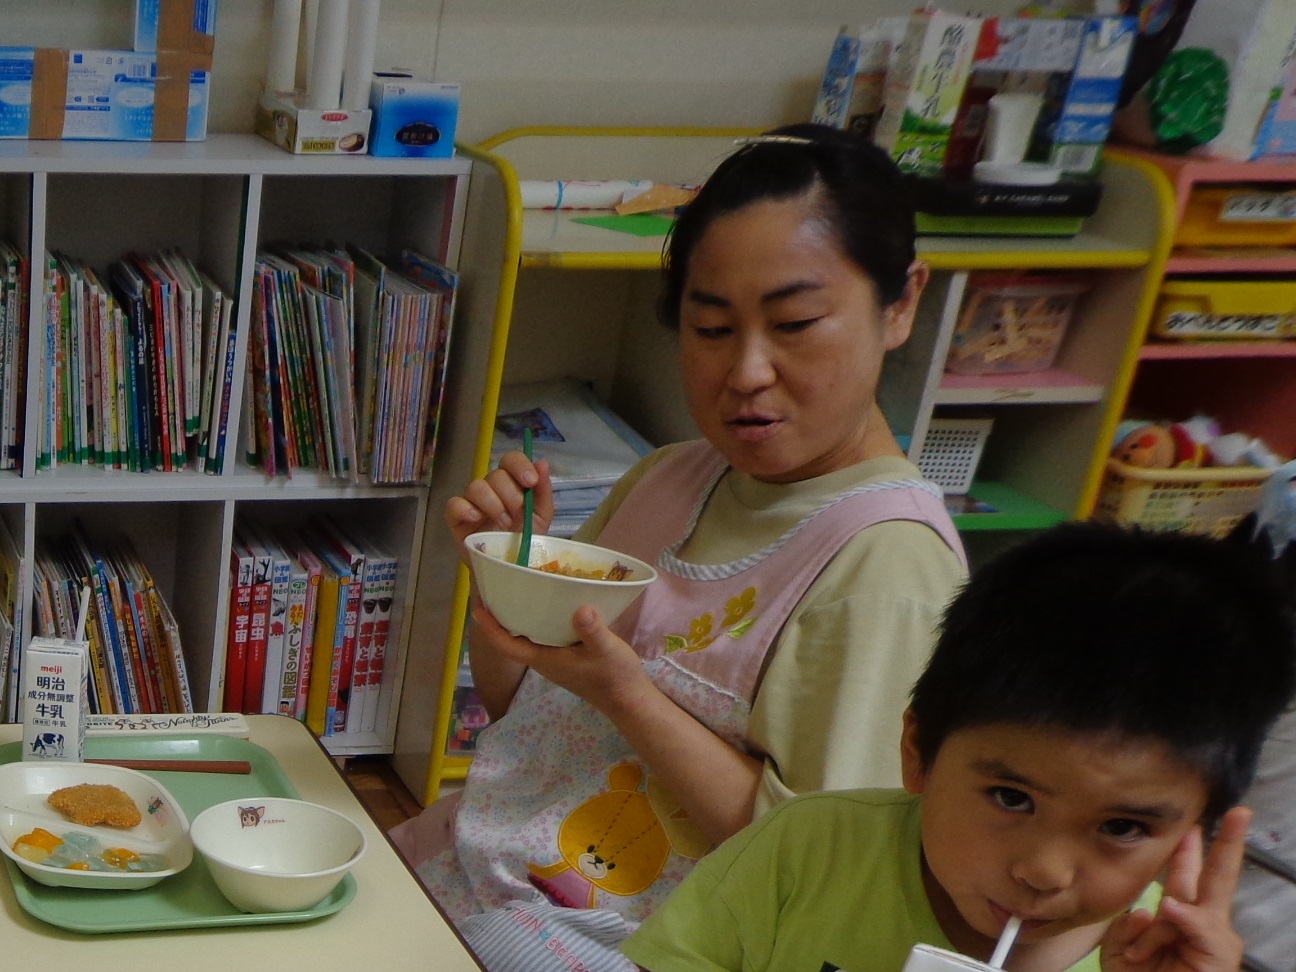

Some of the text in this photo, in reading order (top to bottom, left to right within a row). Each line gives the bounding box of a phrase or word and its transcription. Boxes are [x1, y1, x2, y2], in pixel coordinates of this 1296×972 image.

[235, 615, 249, 643] 宇宙
[251, 612, 265, 640] 昆虫
[269, 621, 284, 636] 魚
[281, 624, 302, 699] ふしぎの図鑑
[40, 665, 62, 675] meiji
[36, 676, 65, 691] 明治
[28, 690, 75, 703] 成分無調整
[36, 703, 65, 719] 牛乳
[509, 907, 543, 935] TWIN
